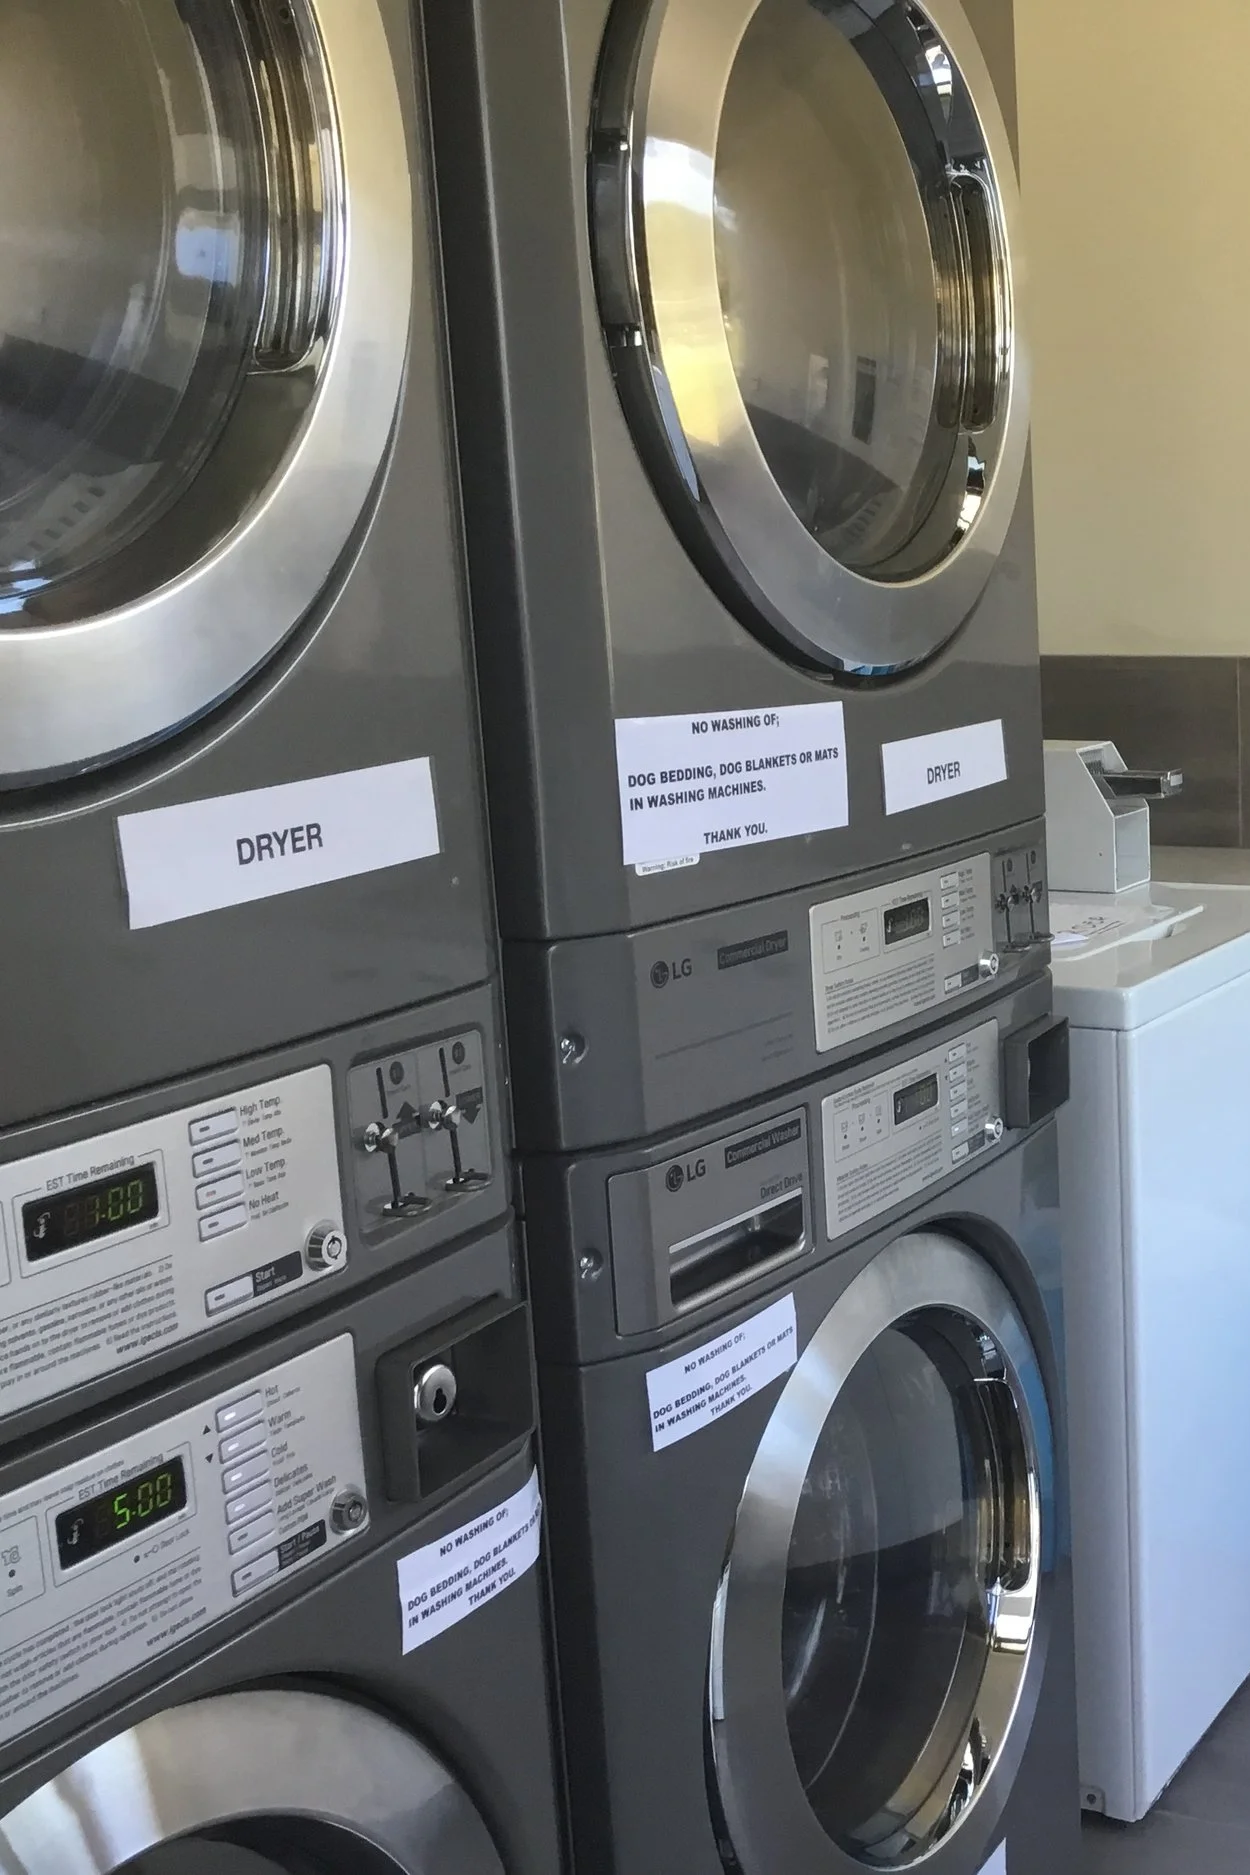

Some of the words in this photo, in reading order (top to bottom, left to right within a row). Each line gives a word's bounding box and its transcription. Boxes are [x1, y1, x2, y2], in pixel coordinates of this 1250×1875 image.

[691, 720, 708, 734] NO
[711, 716, 760, 732] WASHING
[763, 713, 780, 728] OF;
[628, 772, 656, 788] DOG
[660, 765, 716, 784] BEDDING,
[719, 761, 742, 776] DOG
[745, 753, 797, 772] BLANKETS
[799, 751, 813, 764] OR
[814, 747, 839, 762] MATS
[927, 761, 960, 784] DRYER
[630, 798, 643, 811] IN
[647, 789, 705, 809] WASHING
[708, 779, 766, 800] MACHINES.
[236, 822, 324, 865] DRYER
[703, 827, 741, 844] THANK
[744, 822, 768, 837] YOU.
[666, 859, 678, 867] Risk
[672, 958, 692, 980] LG
[240, 1102, 257, 1116] High
[243, 1134, 260, 1147] Med
[726, 1133, 771, 1163] Commercial
[771, 1125, 799, 1145] Washer
[46, 1177, 64, 1191] EST
[66, 1170, 89, 1183] Time
[90, 1155, 135, 1176] Remaining
[245, 1166, 263, 1179] Low
[686, 1159, 706, 1182] LG
[760, 1179, 783, 1199] Direct
[784, 1172, 802, 1189] Drive
[248, 1199, 260, 1210] No
[261, 1191, 280, 1204] Heat
[255, 1266, 275, 1283] Start
[684, 1360, 697, 1374] NO
[698, 1340, 733, 1367] WASHING
[734, 1332, 746, 1344] OF;
[653, 1402, 673, 1419] DOG
[674, 1382, 714, 1408] BEDDING,
[714, 1369, 730, 1385] DOG
[731, 1346, 766, 1374] BLANKETS
[767, 1337, 776, 1349] OR
[776, 1326, 794, 1342] MATS
[265, 1384, 279, 1397] Hot
[655, 1422, 665, 1433] IN
[667, 1400, 706, 1427] WASHING
[708, 1374, 746, 1403] MACHINES.
[710, 1396, 736, 1416] THANK
[736, 1383, 753, 1398] YOU.
[268, 1410, 292, 1427] Warm
[271, 1441, 288, 1458] Cold
[78, 1486, 96, 1500] EST
[99, 1476, 119, 1492] Time
[120, 1454, 163, 1480] Remaining
[274, 1463, 309, 1487] Delicates
[114, 1472, 172, 1529] 5.00
[276, 1499, 293, 1515] Add
[293, 1487, 314, 1508] Super
[316, 1475, 336, 1492] Wash
[439, 1542, 453, 1557] NO
[455, 1518, 494, 1546] WASHING
[408, 1592, 428, 1611] DOG
[430, 1566, 472, 1596] BEDDING,
[473, 1552, 492, 1570] DOG
[493, 1523, 529, 1557] BLANKETS
[7, 1584, 23, 1597] Spin
[409, 1614, 418, 1628] IN
[421, 1589, 463, 1620] WASHING
[465, 1558, 508, 1591] MACHINES.
[468, 1581, 497, 1606] THANK
[499, 1567, 516, 1584] YOU.
